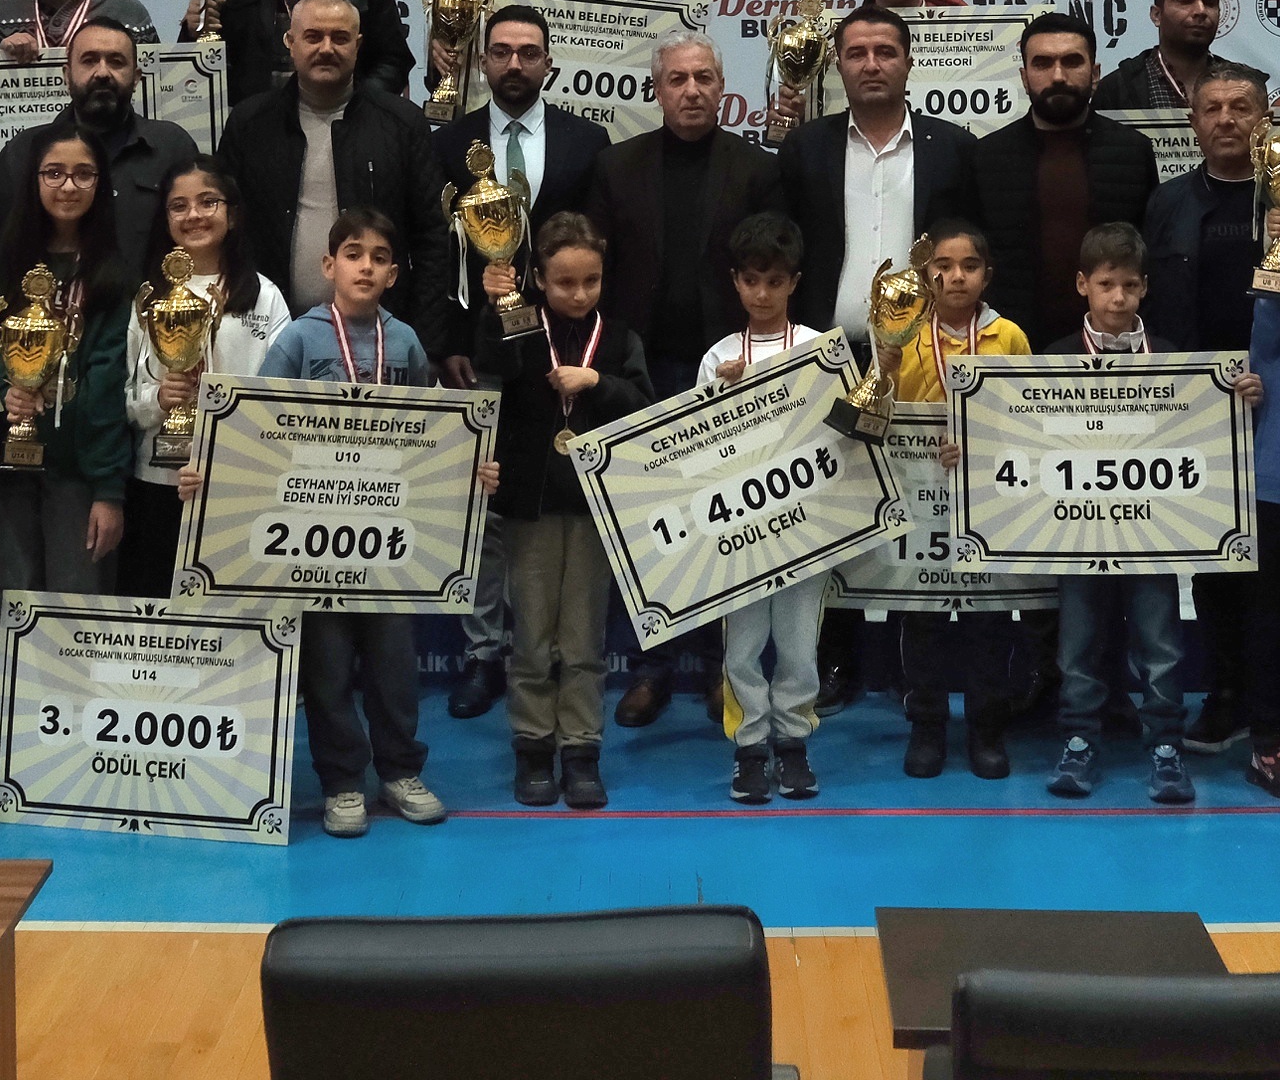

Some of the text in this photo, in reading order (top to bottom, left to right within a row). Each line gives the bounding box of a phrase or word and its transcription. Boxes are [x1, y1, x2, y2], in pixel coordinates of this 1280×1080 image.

[578, 10, 648, 28] BELEDİYESİ
[570, 37, 624, 50] KATEGORİ
[924, 29, 994, 42] BELEDİYESİ
[918, 56, 972, 67] KATEGORİ
[1021, 382, 1175, 401] CEYHAN BELEDİYESİ
[276, 413, 427, 435] CEYHAN BELEDİYESİ
[650, 386, 790, 453] CEYHAN BELEDİYESİ
[1086, 420, 1104, 431] U8
[335, 451, 361, 464] U10
[718, 444, 737, 459] U8
[995, 460, 1029, 488] 4.
[357, 478, 401, 494] İKAMET
[283, 491, 400, 508] EDEN EN İYİ SPORCU
[1053, 499, 1151, 526] ÖDÜL ÇEKİ
[652, 517, 687, 545] 1.
[717, 501, 807, 556] ÖDÜL ÇEKİ
[290, 565, 367, 588] ÖDÜL ÇEKİ
[73, 630, 223, 653] CEYHAN BELEDİYESİ
[132, 669, 157, 681] U14
[39, 704, 71, 736] 3.
[91, 753, 186, 783] ÖDÜL ÇEKİ
